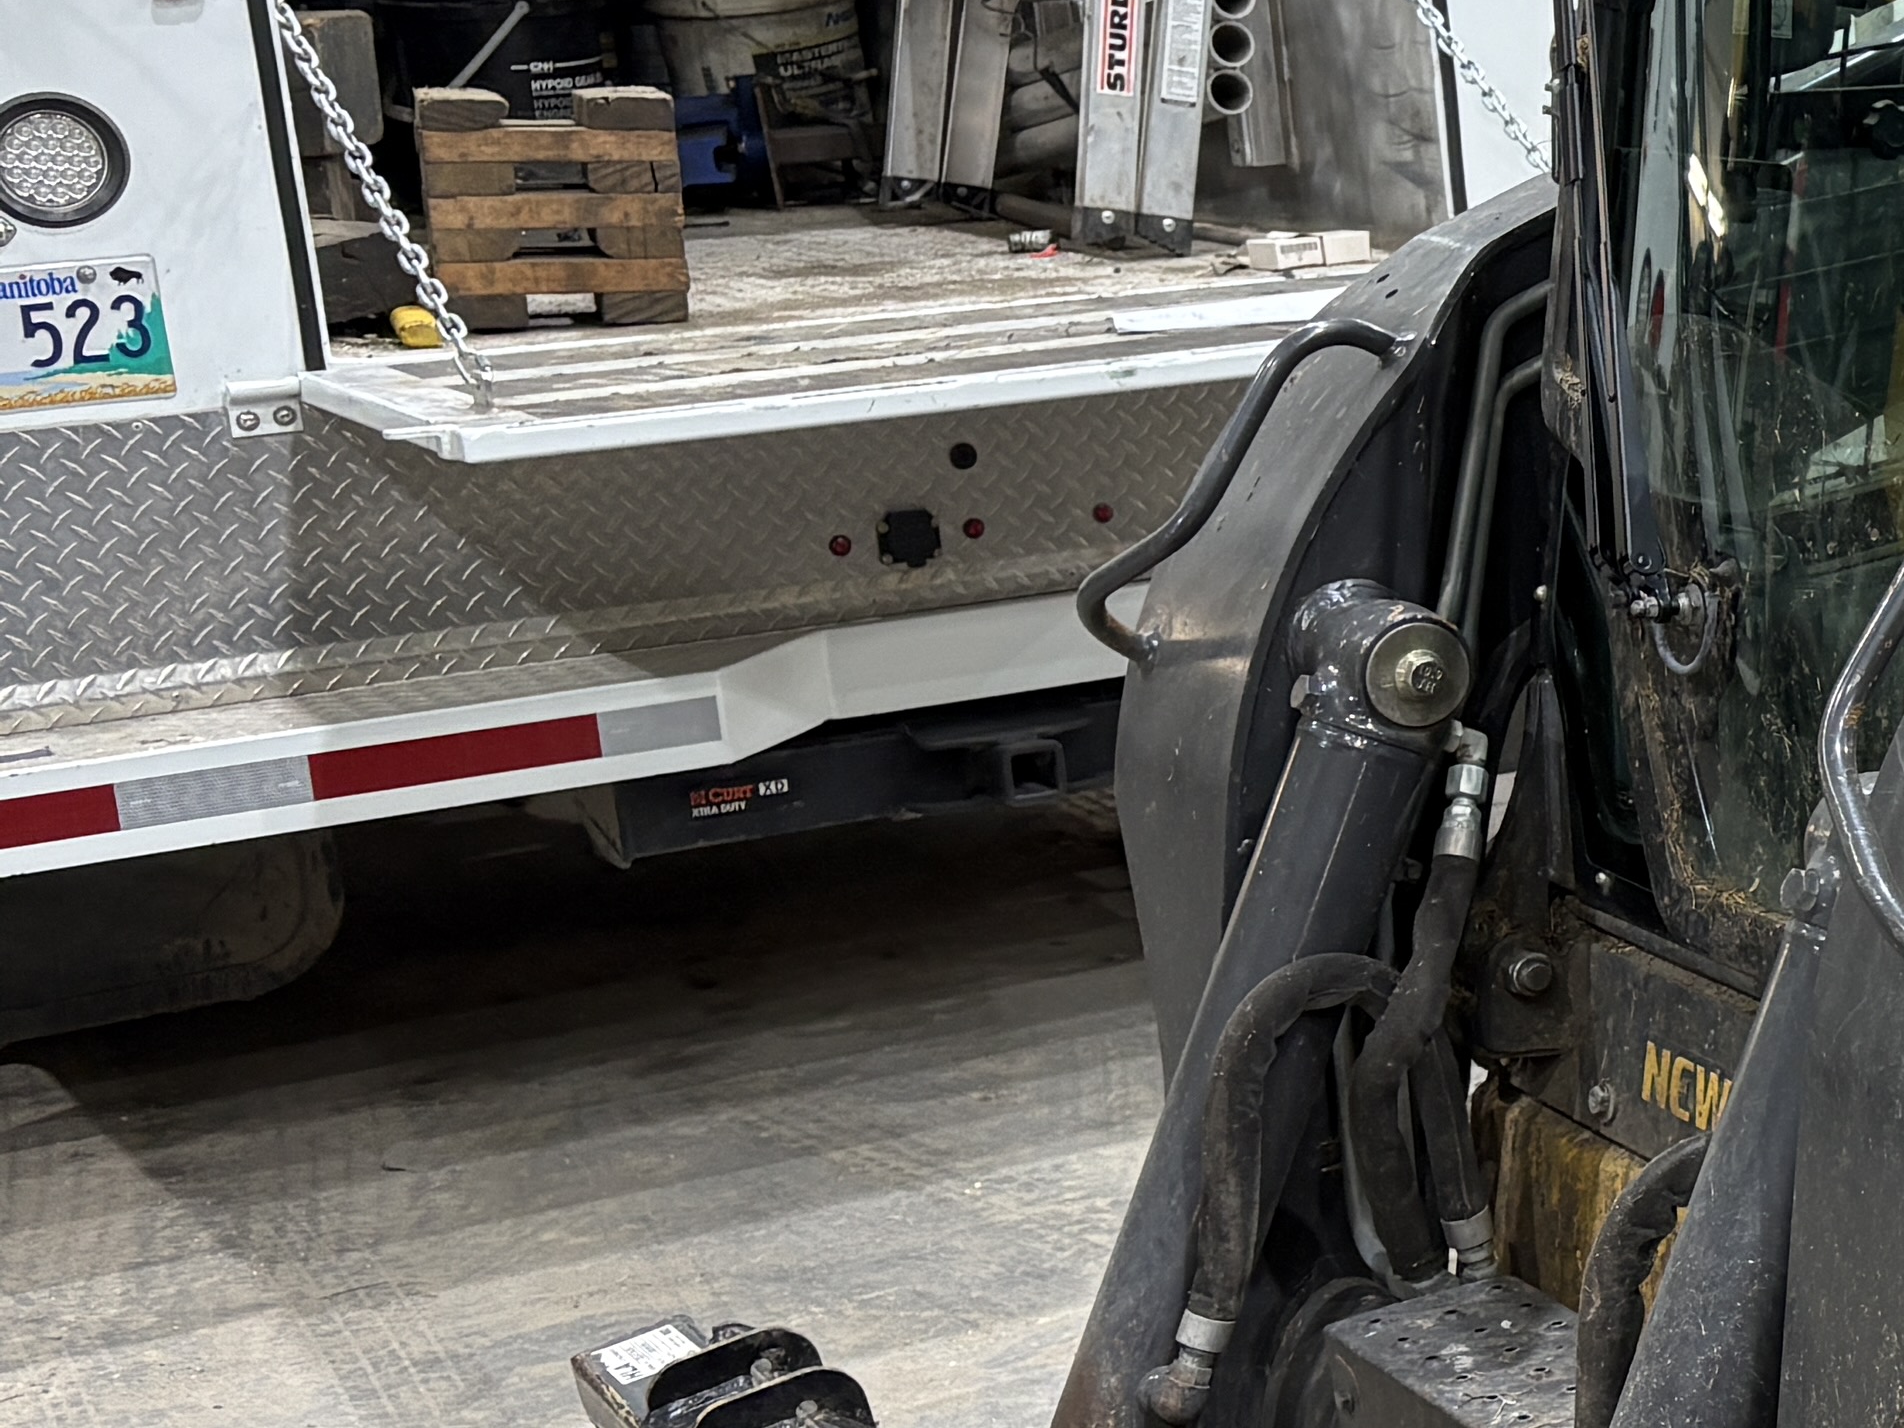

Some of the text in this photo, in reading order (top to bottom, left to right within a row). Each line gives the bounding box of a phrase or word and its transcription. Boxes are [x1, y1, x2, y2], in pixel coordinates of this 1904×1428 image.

[531, 77, 573, 91] HYPOID
[20, 294, 152, 368] 523
[1641, 1040, 1733, 1132] NEW
